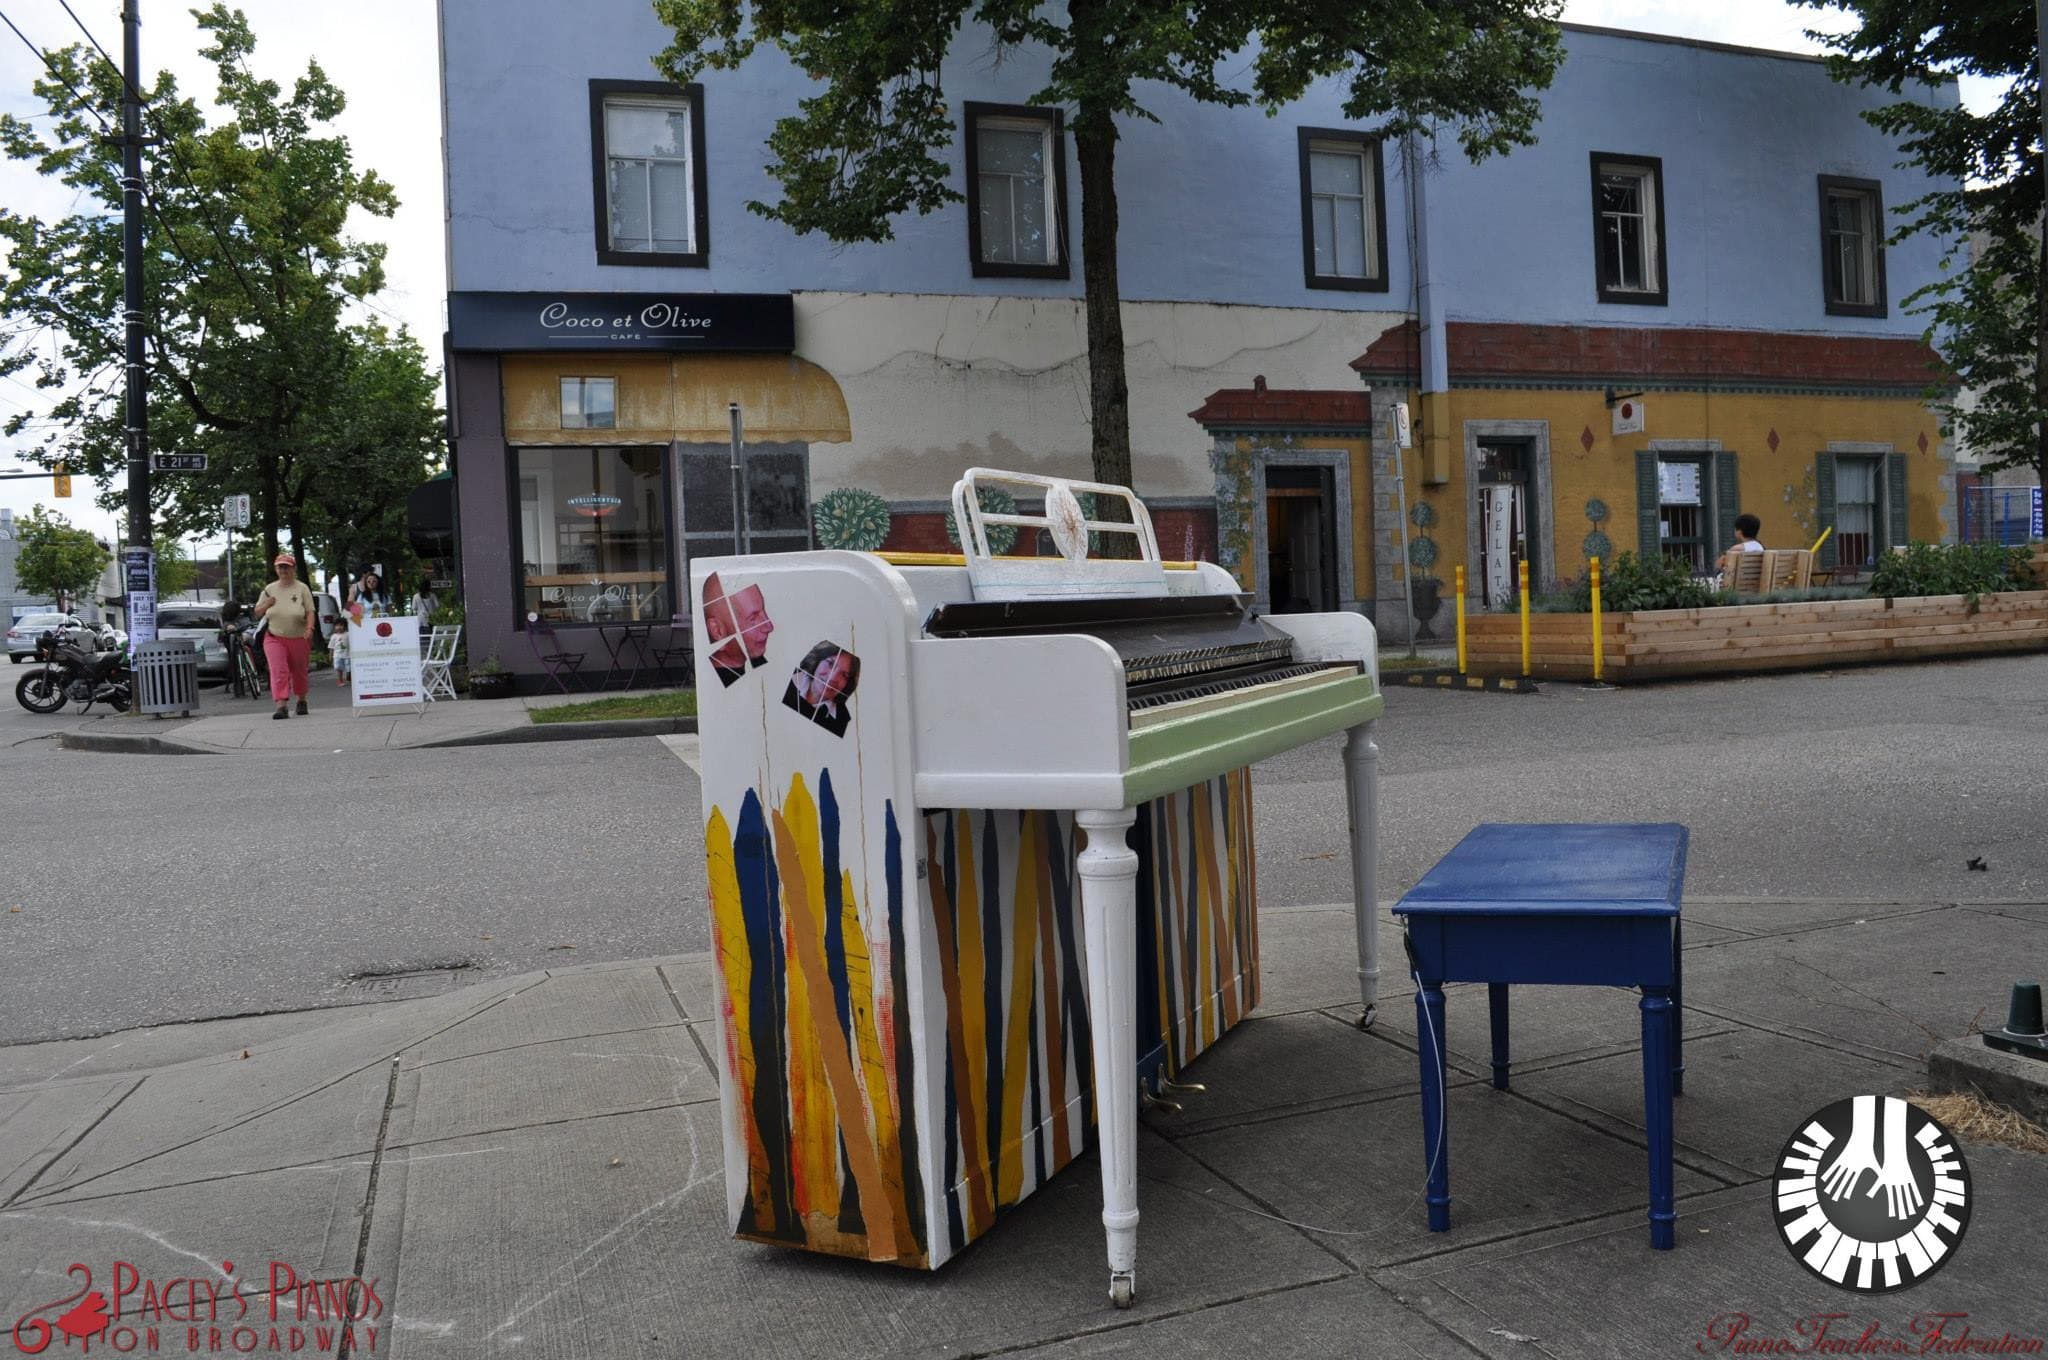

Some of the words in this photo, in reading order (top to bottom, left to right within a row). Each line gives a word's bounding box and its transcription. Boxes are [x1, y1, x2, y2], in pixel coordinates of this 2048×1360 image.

[540, 302, 604, 329] Coco
[612, 314, 633, 328] et
[640, 302, 712, 329] Olive
[159, 457, 167, 468] E
[550, 586, 584, 603] Coco
